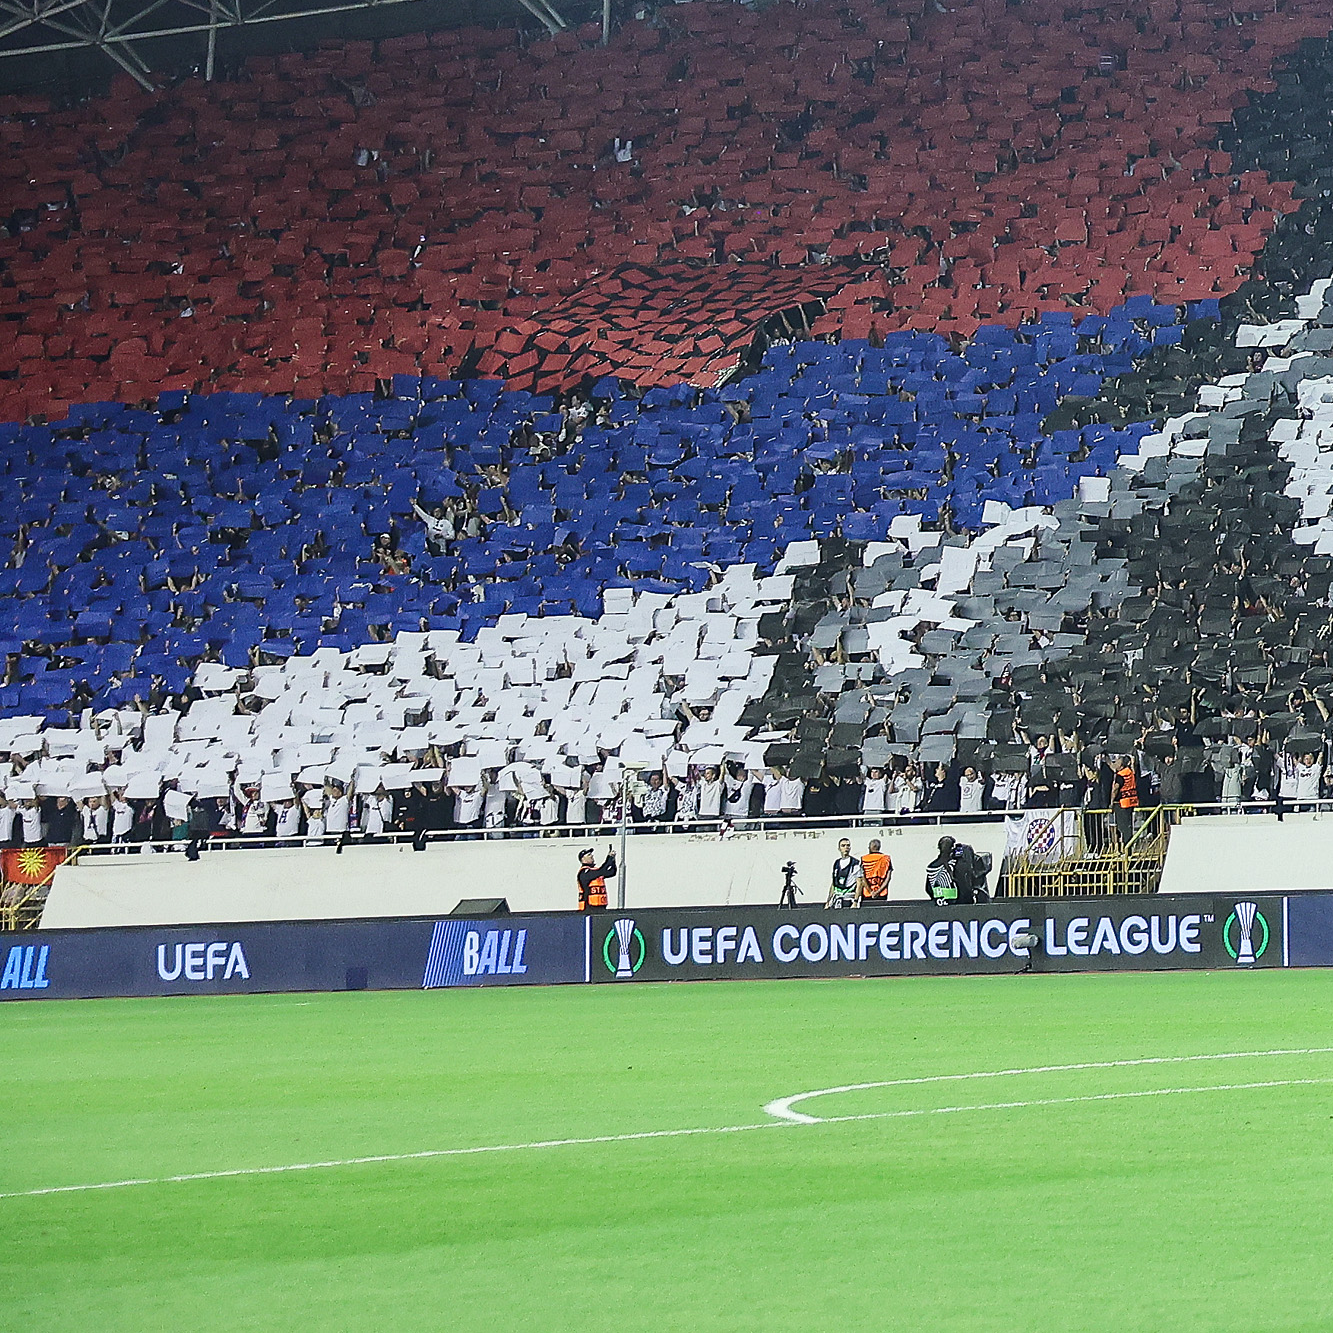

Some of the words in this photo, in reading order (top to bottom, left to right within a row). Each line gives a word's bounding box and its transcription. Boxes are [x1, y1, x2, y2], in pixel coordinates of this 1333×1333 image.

[157, 941, 251, 981] UEFA
[463, 928, 528, 975] BALL
[662, 926, 764, 965] UEFA
[772, 918, 1033, 963] CONFERENCE
[1045, 914, 1202, 956] LEAGUE
[0, 945, 50, 990] ALL
